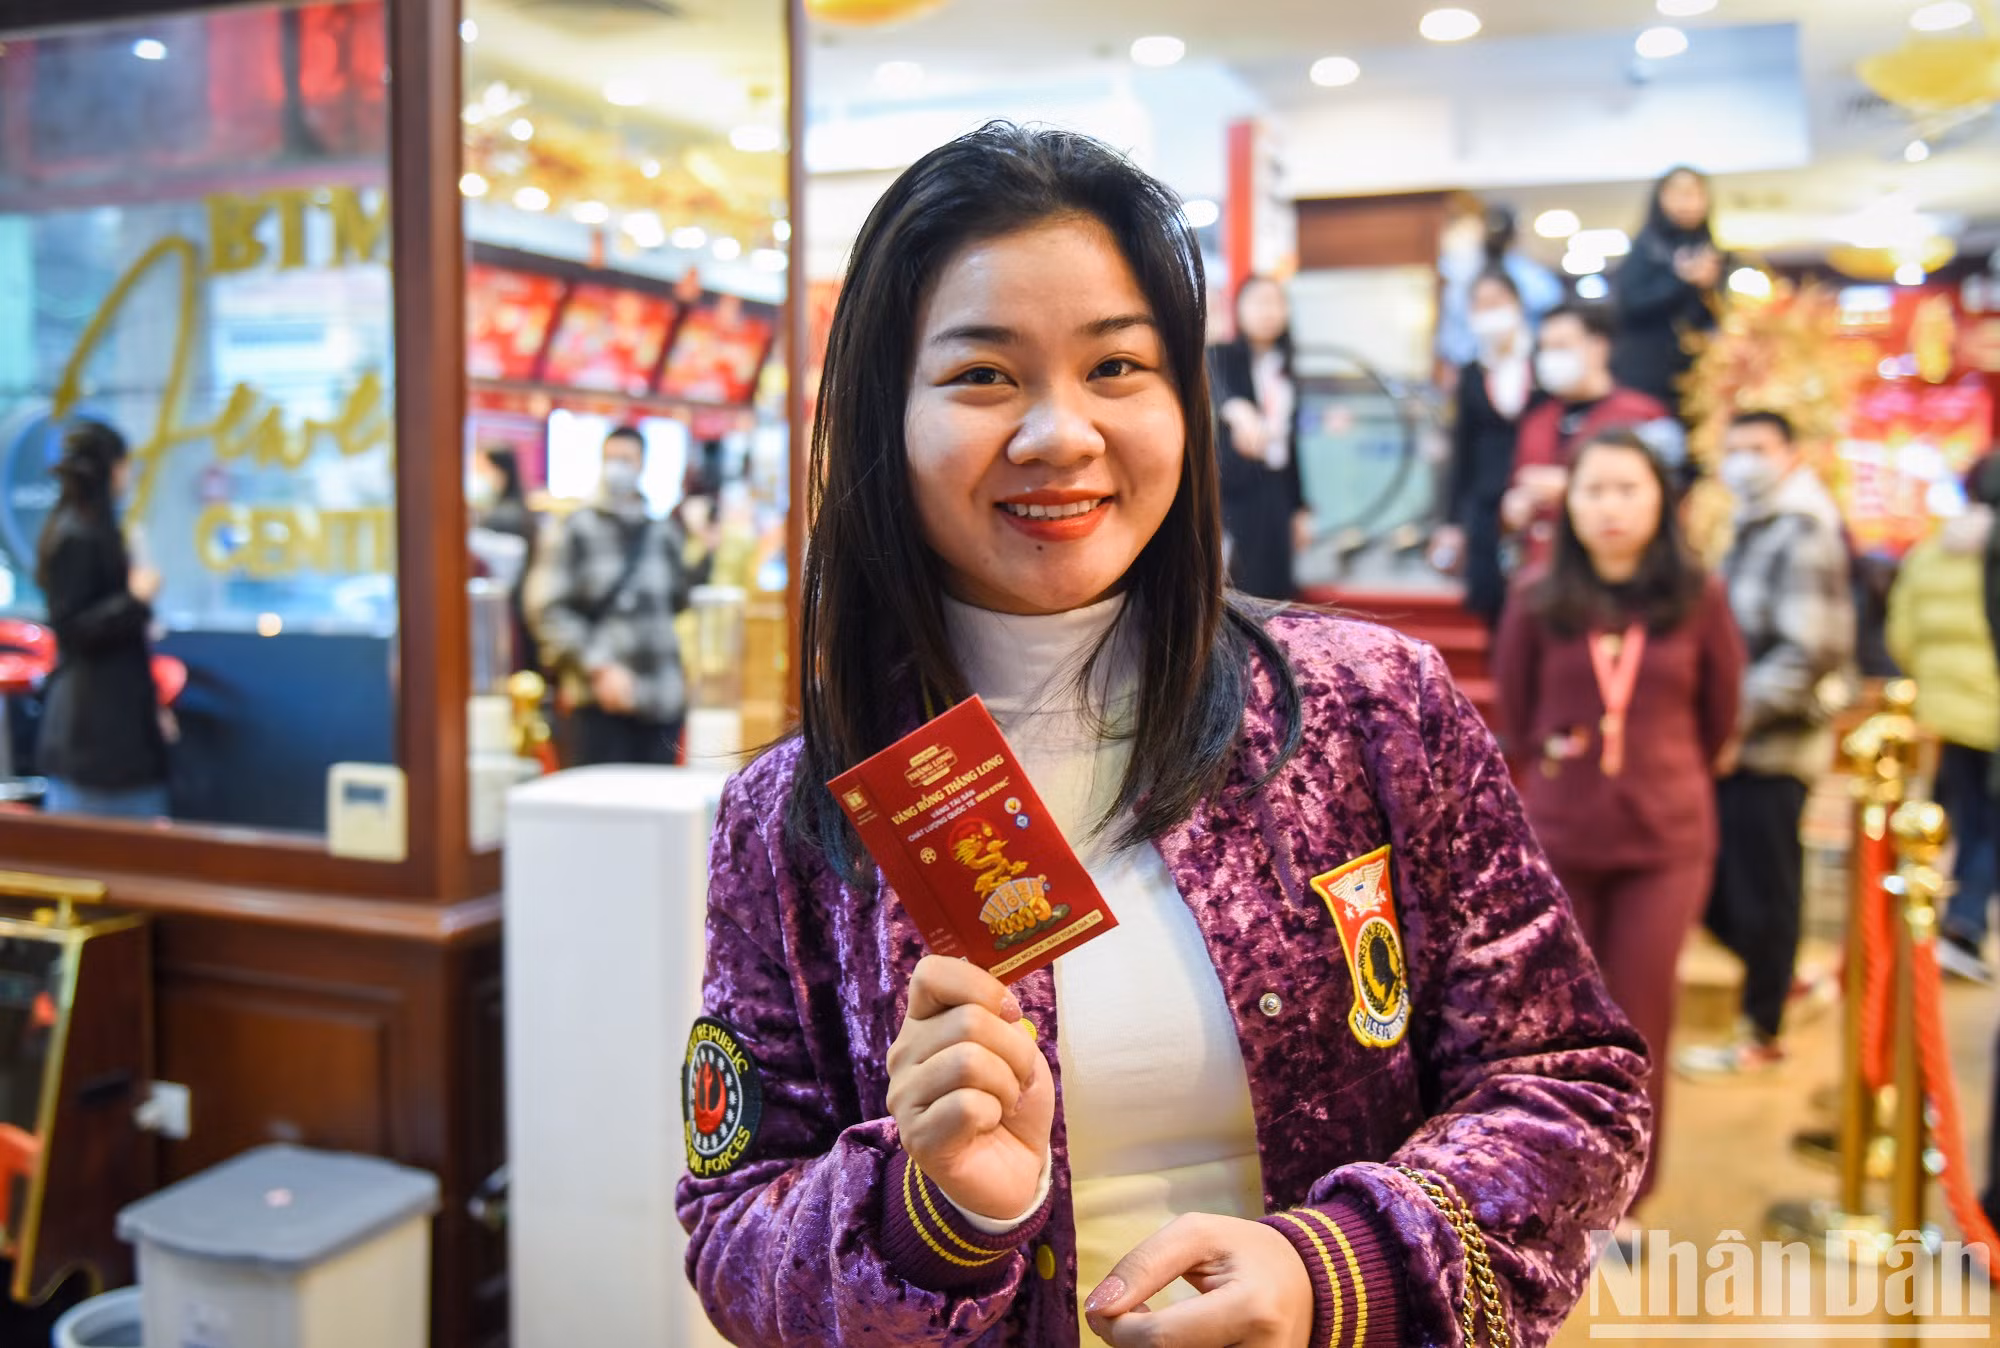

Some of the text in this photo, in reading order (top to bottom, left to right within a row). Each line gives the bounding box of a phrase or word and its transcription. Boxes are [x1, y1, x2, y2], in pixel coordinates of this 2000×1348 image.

[52, 232, 392, 528] Jewe
[889, 802, 919, 826] VÀNG
[913, 785, 945, 812] RỒNG
[940, 767, 979, 796] THĂNG
[974, 753, 1005, 776] LONG
[696, 1023, 748, 1075] REPUBLIC
[704, 1125, 750, 1176] FORCES
